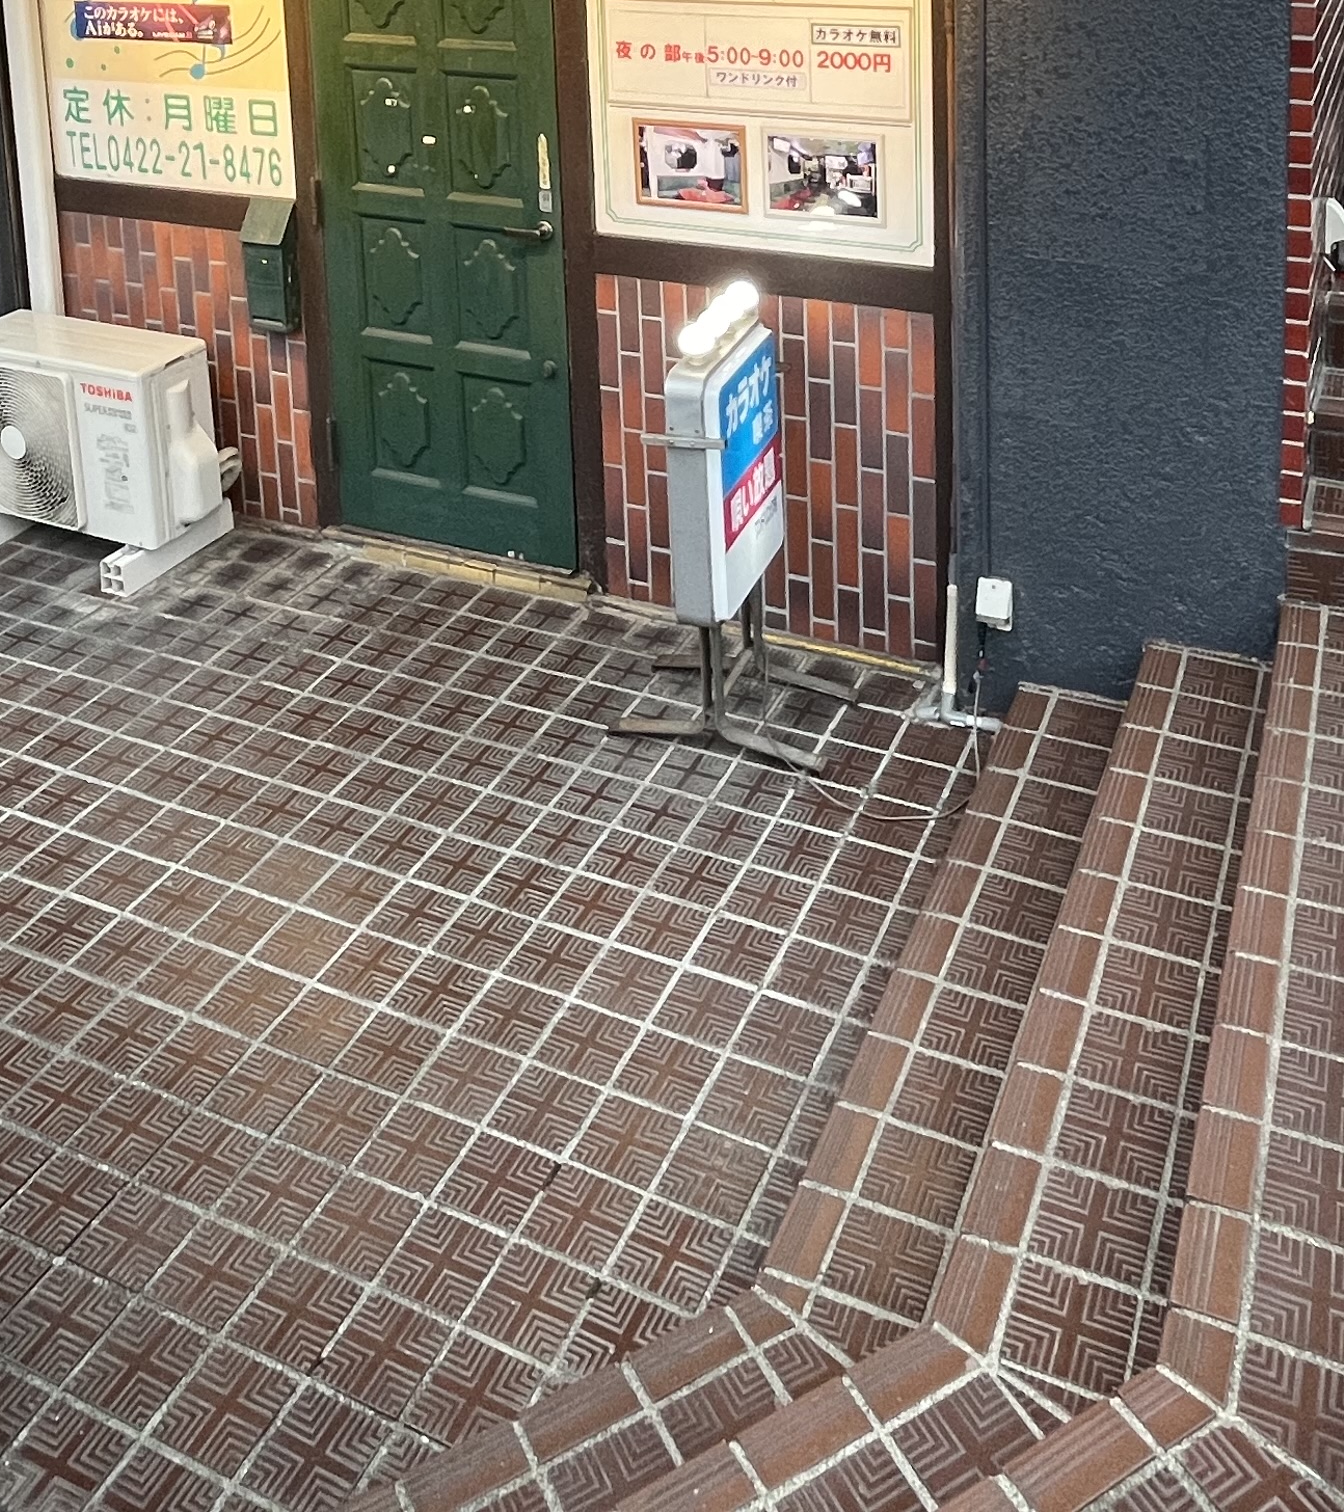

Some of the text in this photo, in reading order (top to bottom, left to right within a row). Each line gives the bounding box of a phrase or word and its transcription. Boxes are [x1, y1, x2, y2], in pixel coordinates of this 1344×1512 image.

[84, 5, 184, 23] このカラオケには、
[85, 22, 144, 38] Aiがある。
[814, 27, 899, 45] カラオケ無料
[816, 51, 892, 73] 2000円
[716, 72, 798, 88] ワンドリンク付
[80, 382, 133, 402] TOSHIBA
[726, 355, 772, 438] カラオケ
